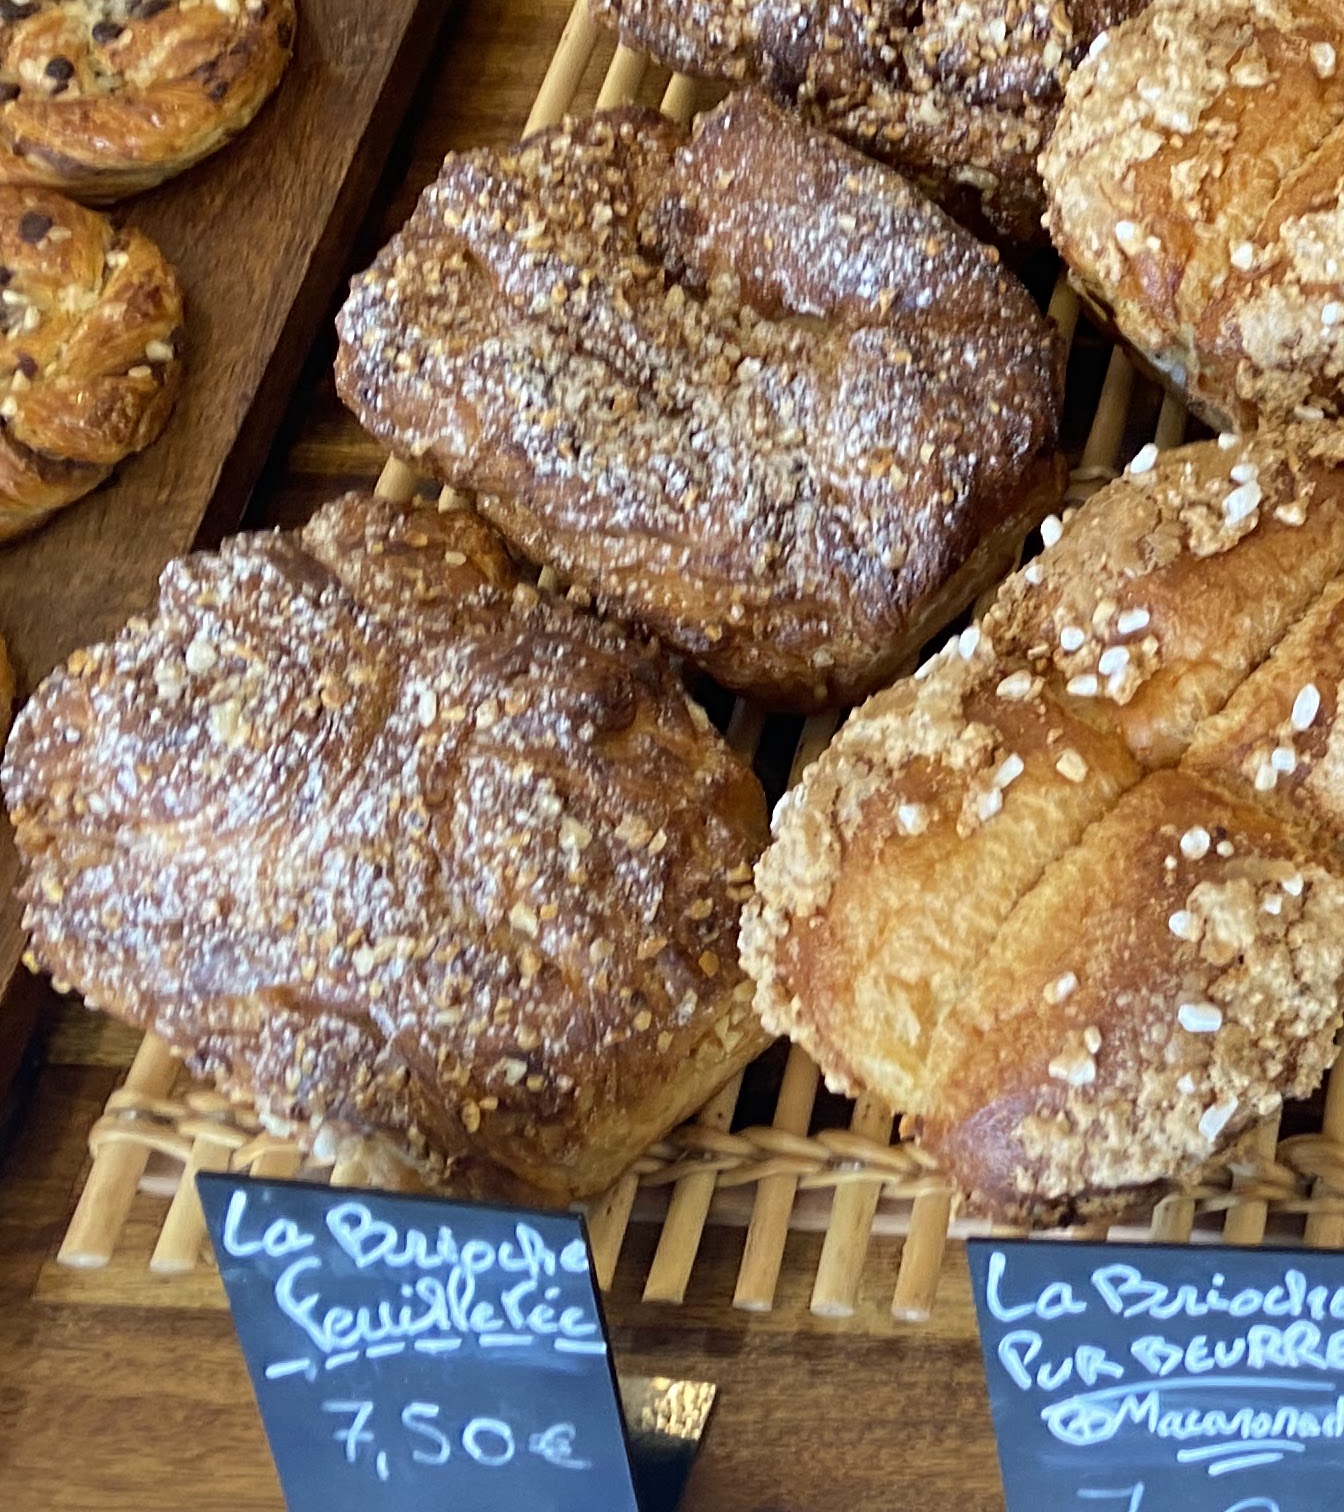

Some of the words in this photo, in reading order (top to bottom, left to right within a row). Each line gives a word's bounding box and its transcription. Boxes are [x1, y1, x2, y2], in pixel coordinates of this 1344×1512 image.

[224, 1190, 314, 1257] La
[326, 1202, 589, 1277] Brioche
[986, 1251, 1087, 1322] La
